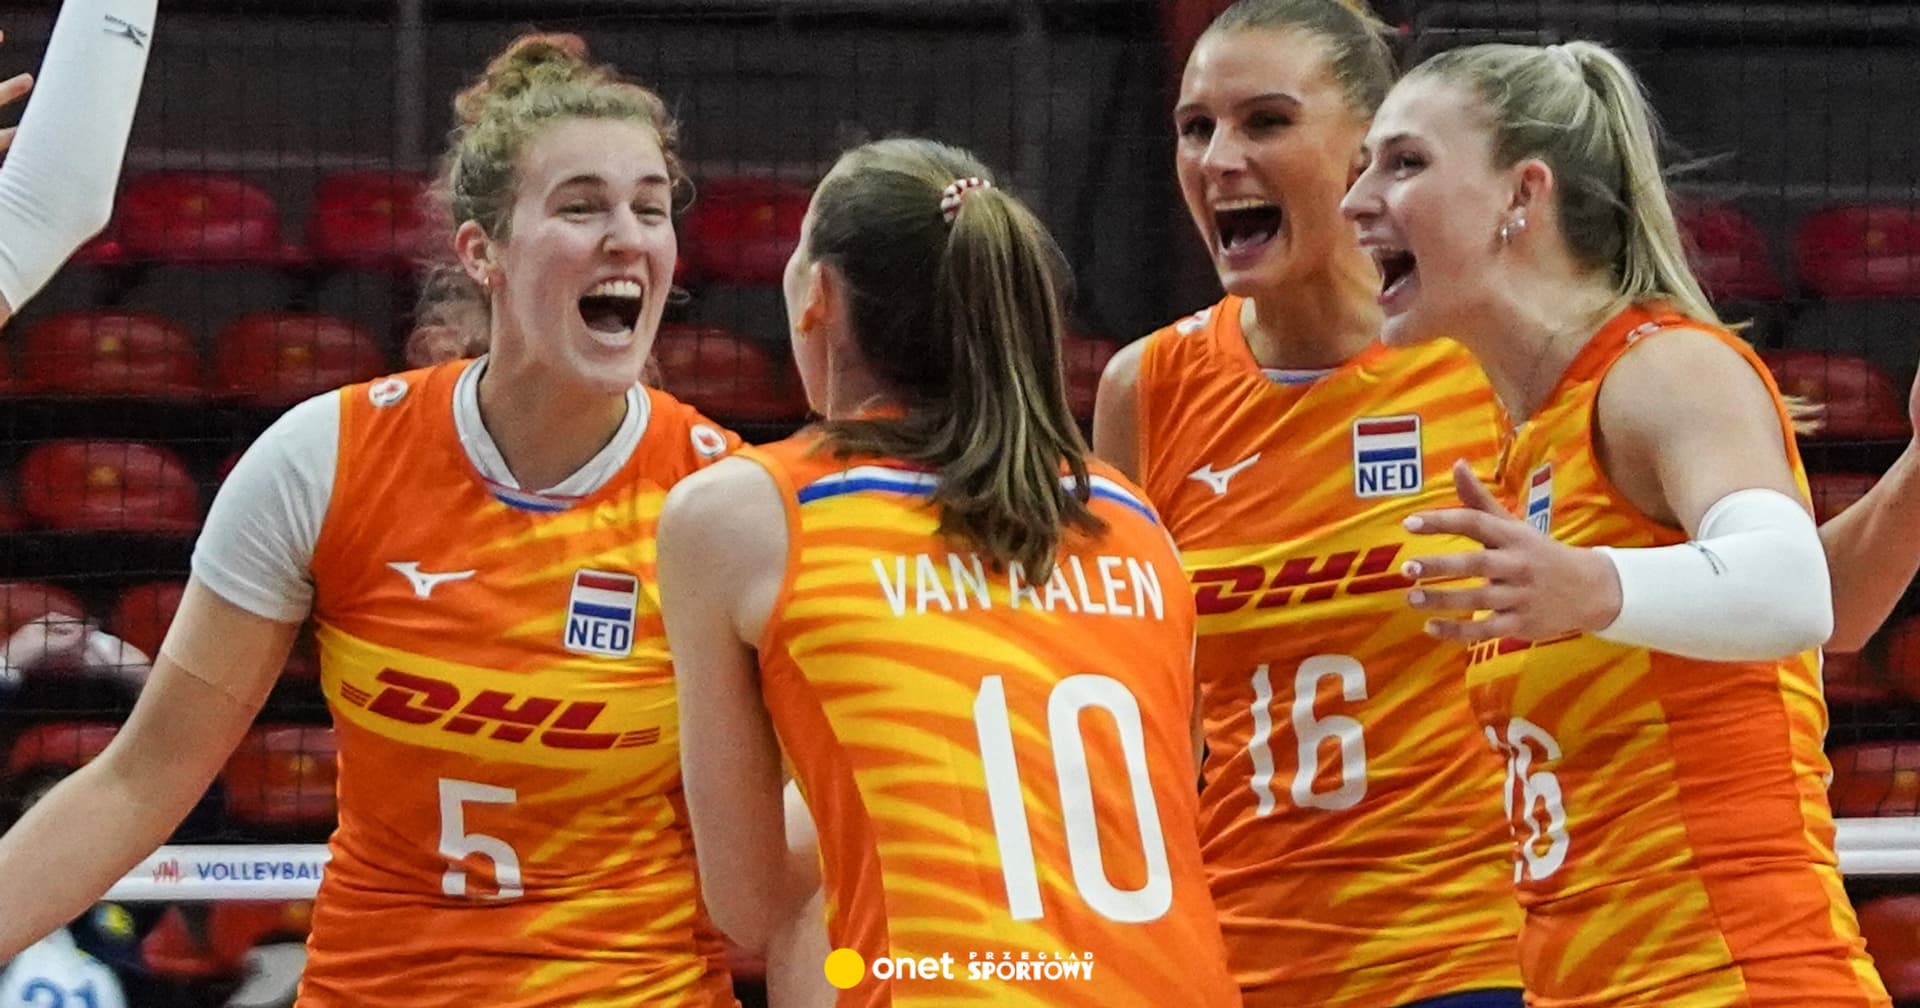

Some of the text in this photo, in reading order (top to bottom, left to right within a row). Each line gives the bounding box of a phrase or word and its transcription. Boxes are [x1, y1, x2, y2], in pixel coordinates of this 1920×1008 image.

[1359, 463, 1418, 493] NED
[872, 553, 1174, 620] VAN AALEN
[1191, 543, 1418, 616] DHL
[568, 618, 630, 651] NED
[366, 667, 620, 750] DHL
[1248, 654, 1368, 817] 16
[973, 673, 1173, 923] 10
[438, 777, 524, 898] 5
